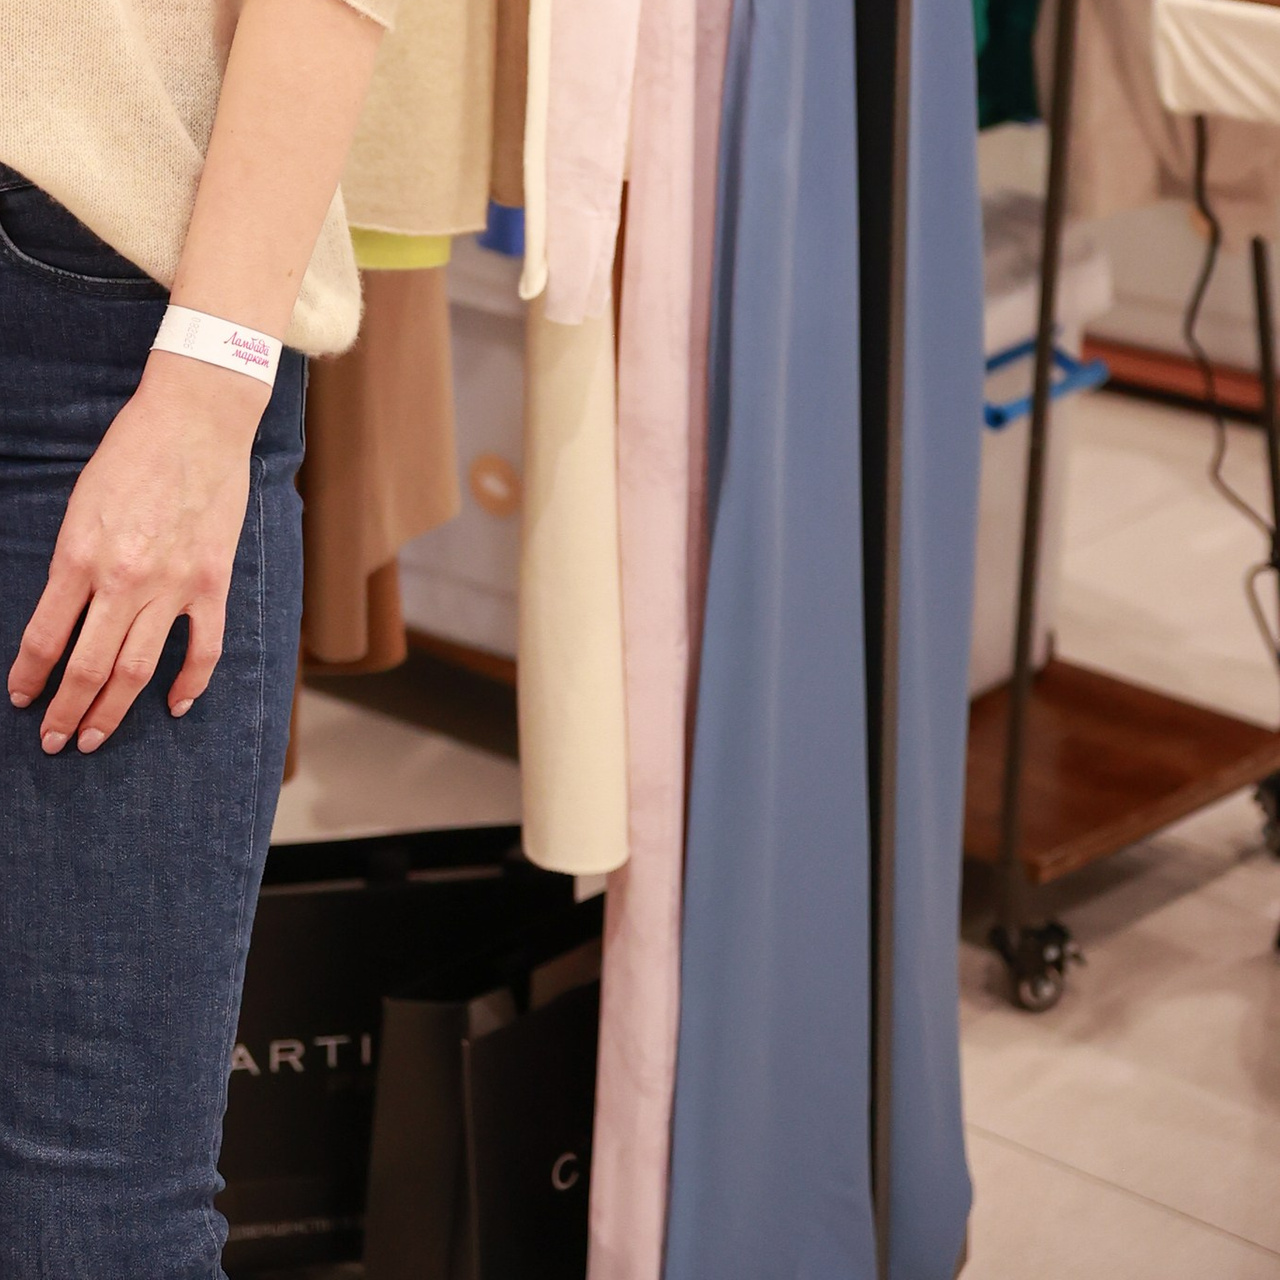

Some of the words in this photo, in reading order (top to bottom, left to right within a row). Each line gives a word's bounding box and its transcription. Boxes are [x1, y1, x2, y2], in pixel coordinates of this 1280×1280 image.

[224, 331, 270, 356] Ламбада
[231, 348, 270, 368] маркет
[229, 1032, 372, 1077] ARTI
